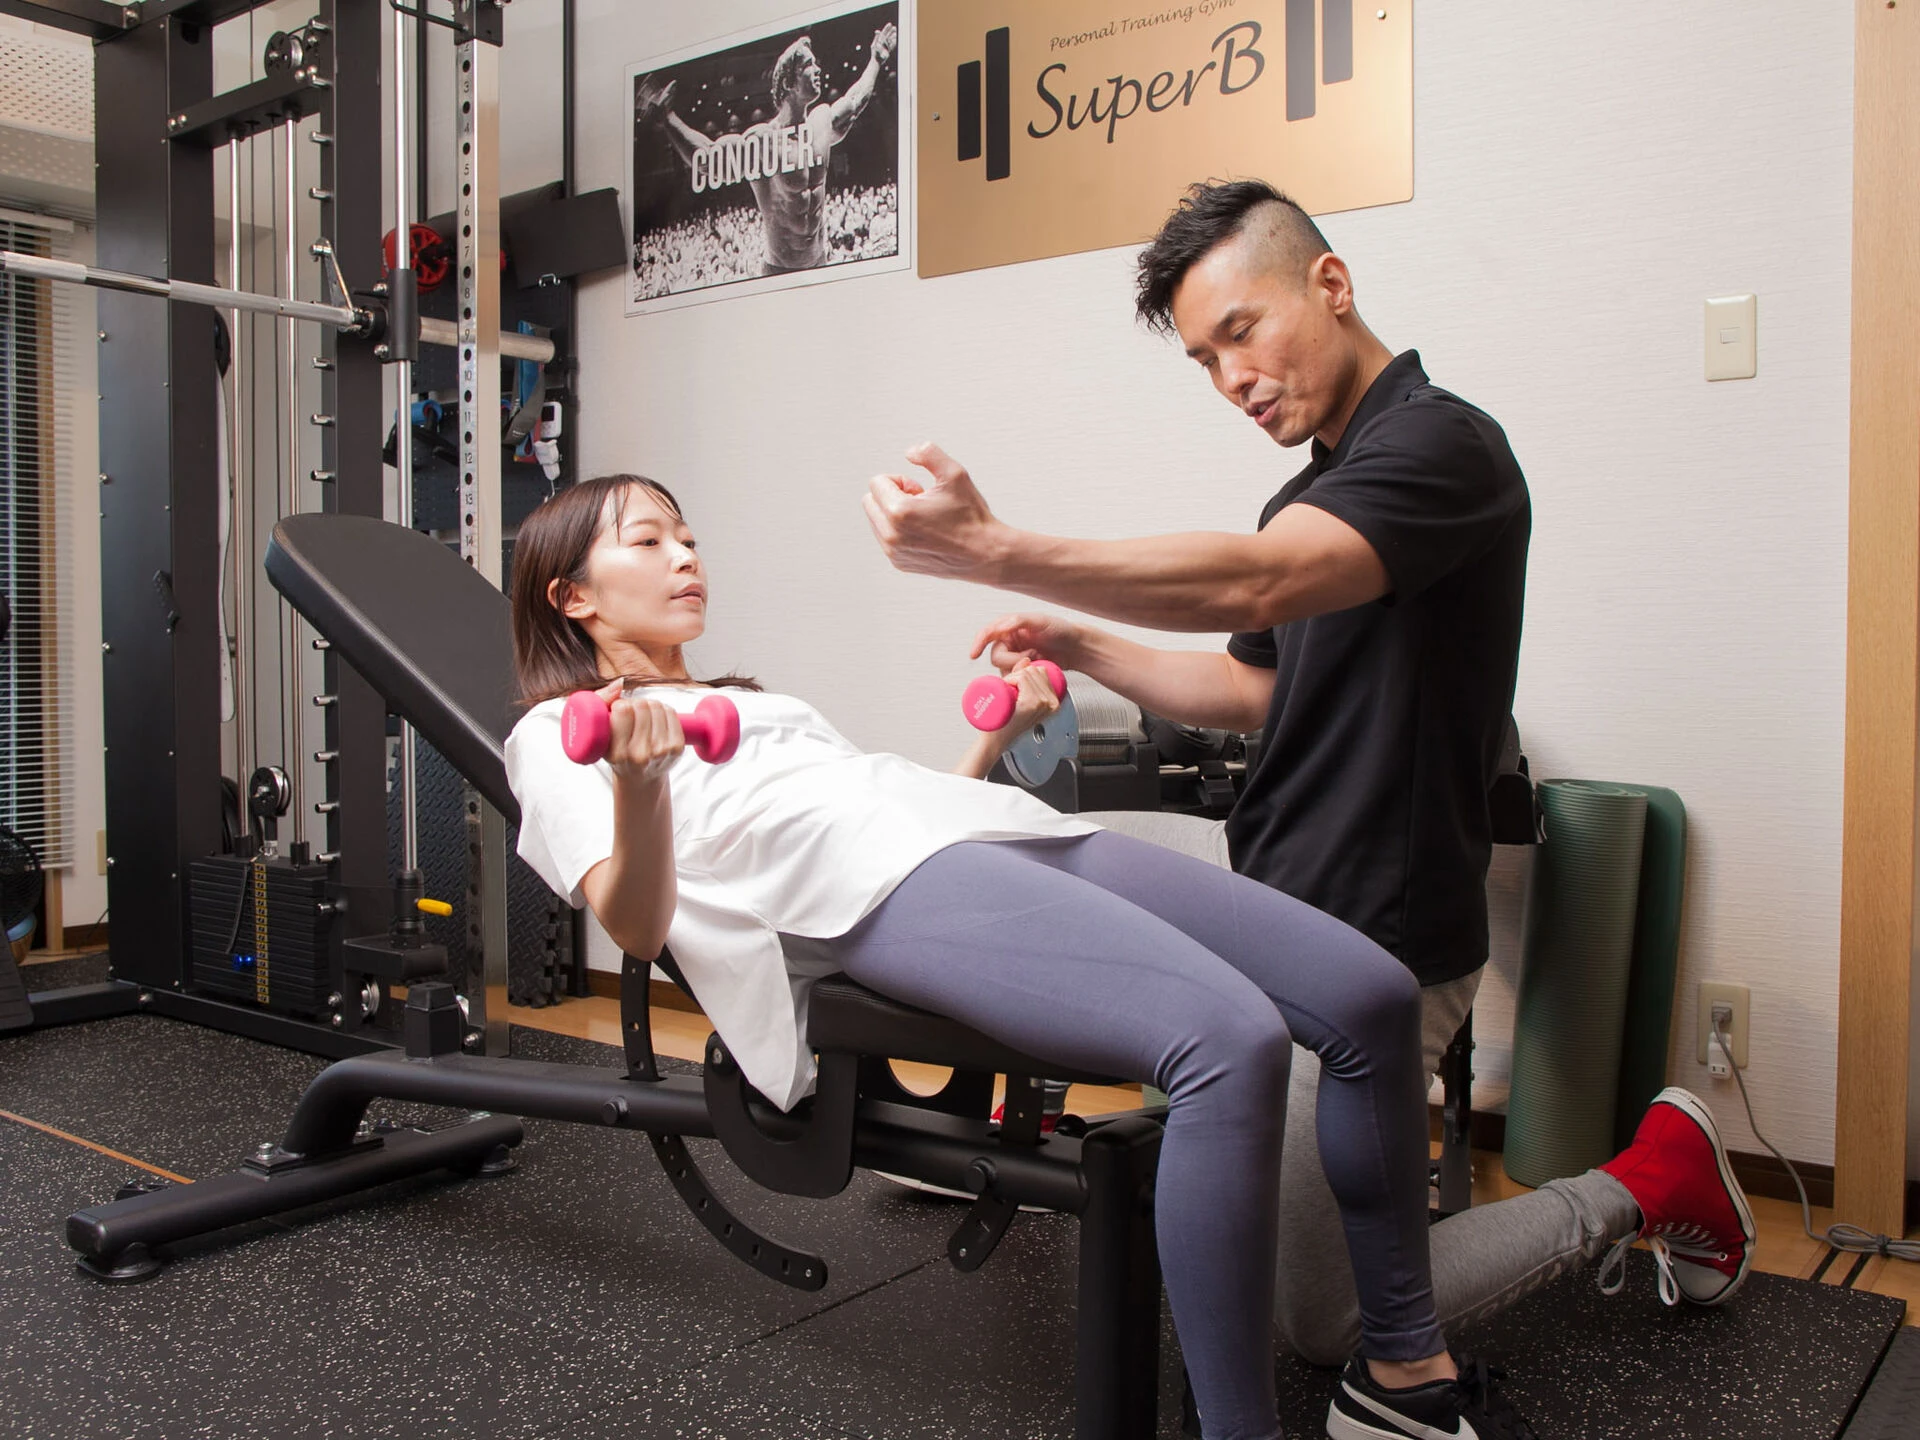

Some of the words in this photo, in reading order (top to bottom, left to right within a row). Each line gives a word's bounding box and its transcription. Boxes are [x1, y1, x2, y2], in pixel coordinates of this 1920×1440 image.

[1050, 21, 1116, 51] Personal
[1121, 5, 1195, 33] Training
[1027, 20, 1265, 144] SuperB
[691, 122, 823, 194] CONQUER.
[463, 164, 470, 176] 5
[464, 205, 470, 217] 6
[464, 246, 470, 258] 7
[464, 288, 470, 299] 8
[464, 328, 471, 340] 9
[463, 370, 472, 381] 10
[464, 411, 471, 423] 11
[464, 452, 472, 464] 12
[464, 493, 473, 505] 13
[465, 535, 474, 546] 14
